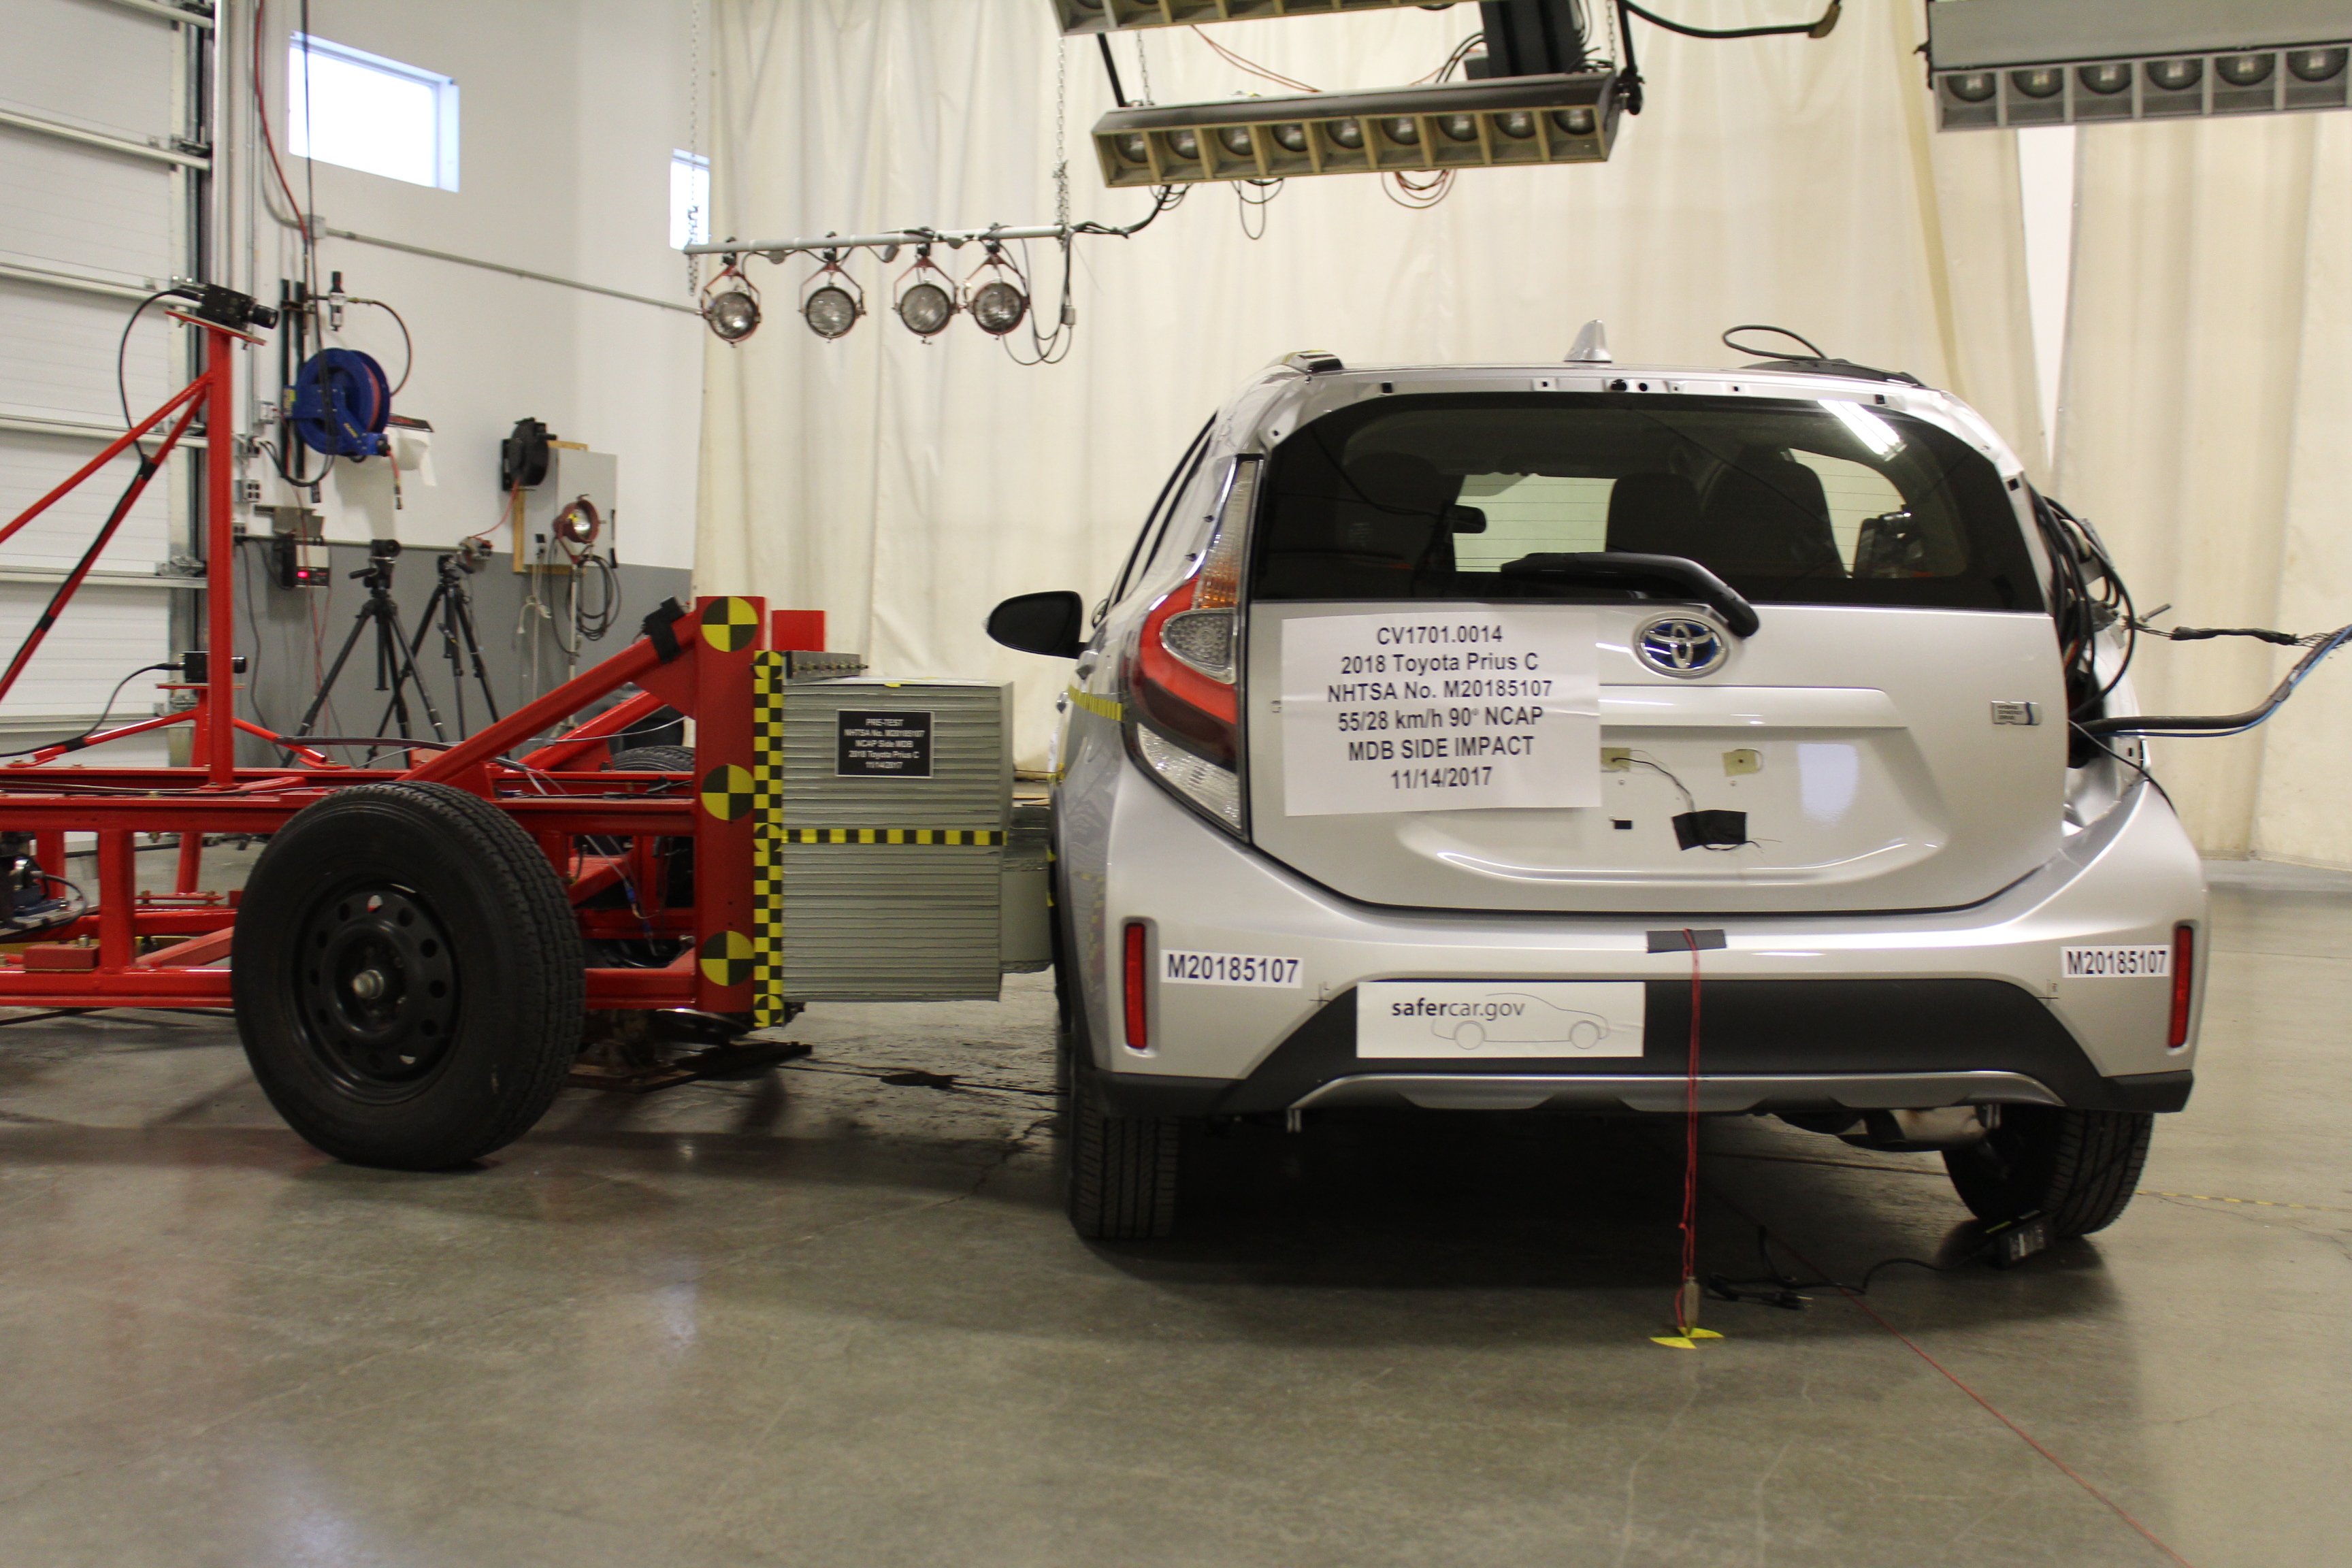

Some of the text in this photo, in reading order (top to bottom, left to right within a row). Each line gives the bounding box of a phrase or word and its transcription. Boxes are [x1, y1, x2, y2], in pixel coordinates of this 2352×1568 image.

[1377, 625, 1503, 645] CV1701.0014
[1341, 651, 1539, 676] 2018 Toyota Prius C
[1327, 679, 1553, 703] NHTSA No. M20185107
[1338, 710, 1389, 732] 55/28
[1395, 708, 1443, 730] km/h
[1484, 706, 1544, 725] NCAP
[866, 750, 892, 760] Toyota
[892, 751, 913, 759] Prius
[912, 751, 921, 759] C
[1348, 735, 1535, 761] MDB SIDE IMPACT
[1390, 765, 1494, 789] 11/14/2017
[1167, 953, 1299, 983] M20185107
[2066, 950, 2168, 975] M20185107
[1392, 997, 1524, 1022] safercar.gov
